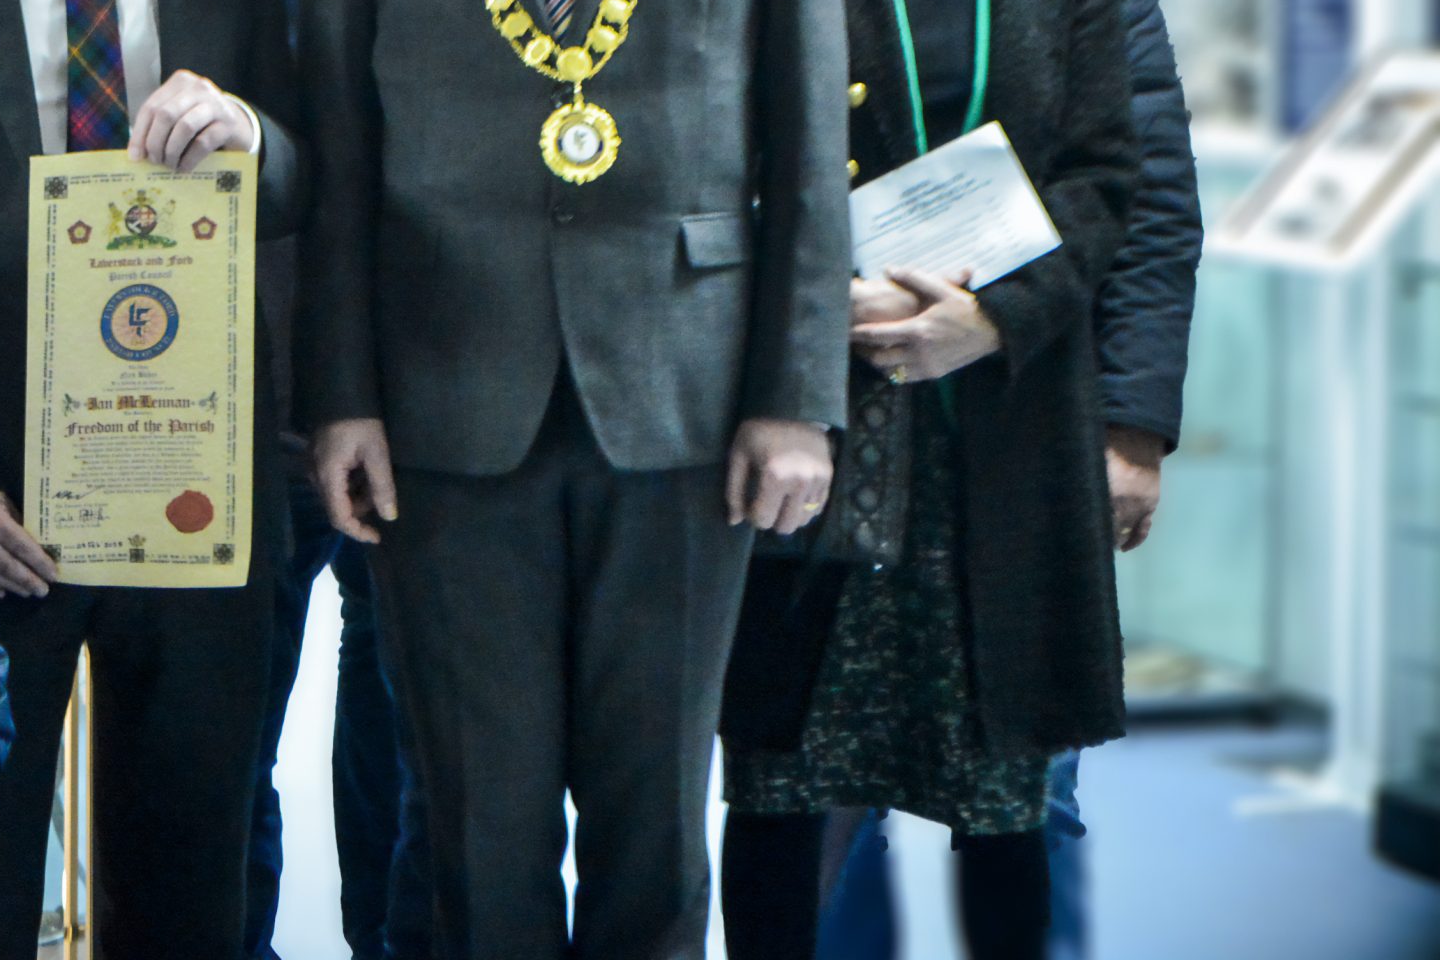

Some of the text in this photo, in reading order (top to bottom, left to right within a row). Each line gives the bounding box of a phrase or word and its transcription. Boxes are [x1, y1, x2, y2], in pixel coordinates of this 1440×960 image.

[145, 256, 164, 266] and
[87, 394, 191, 410] Ian McLennan
[64, 418, 215, 438] Freedom of the Parish
